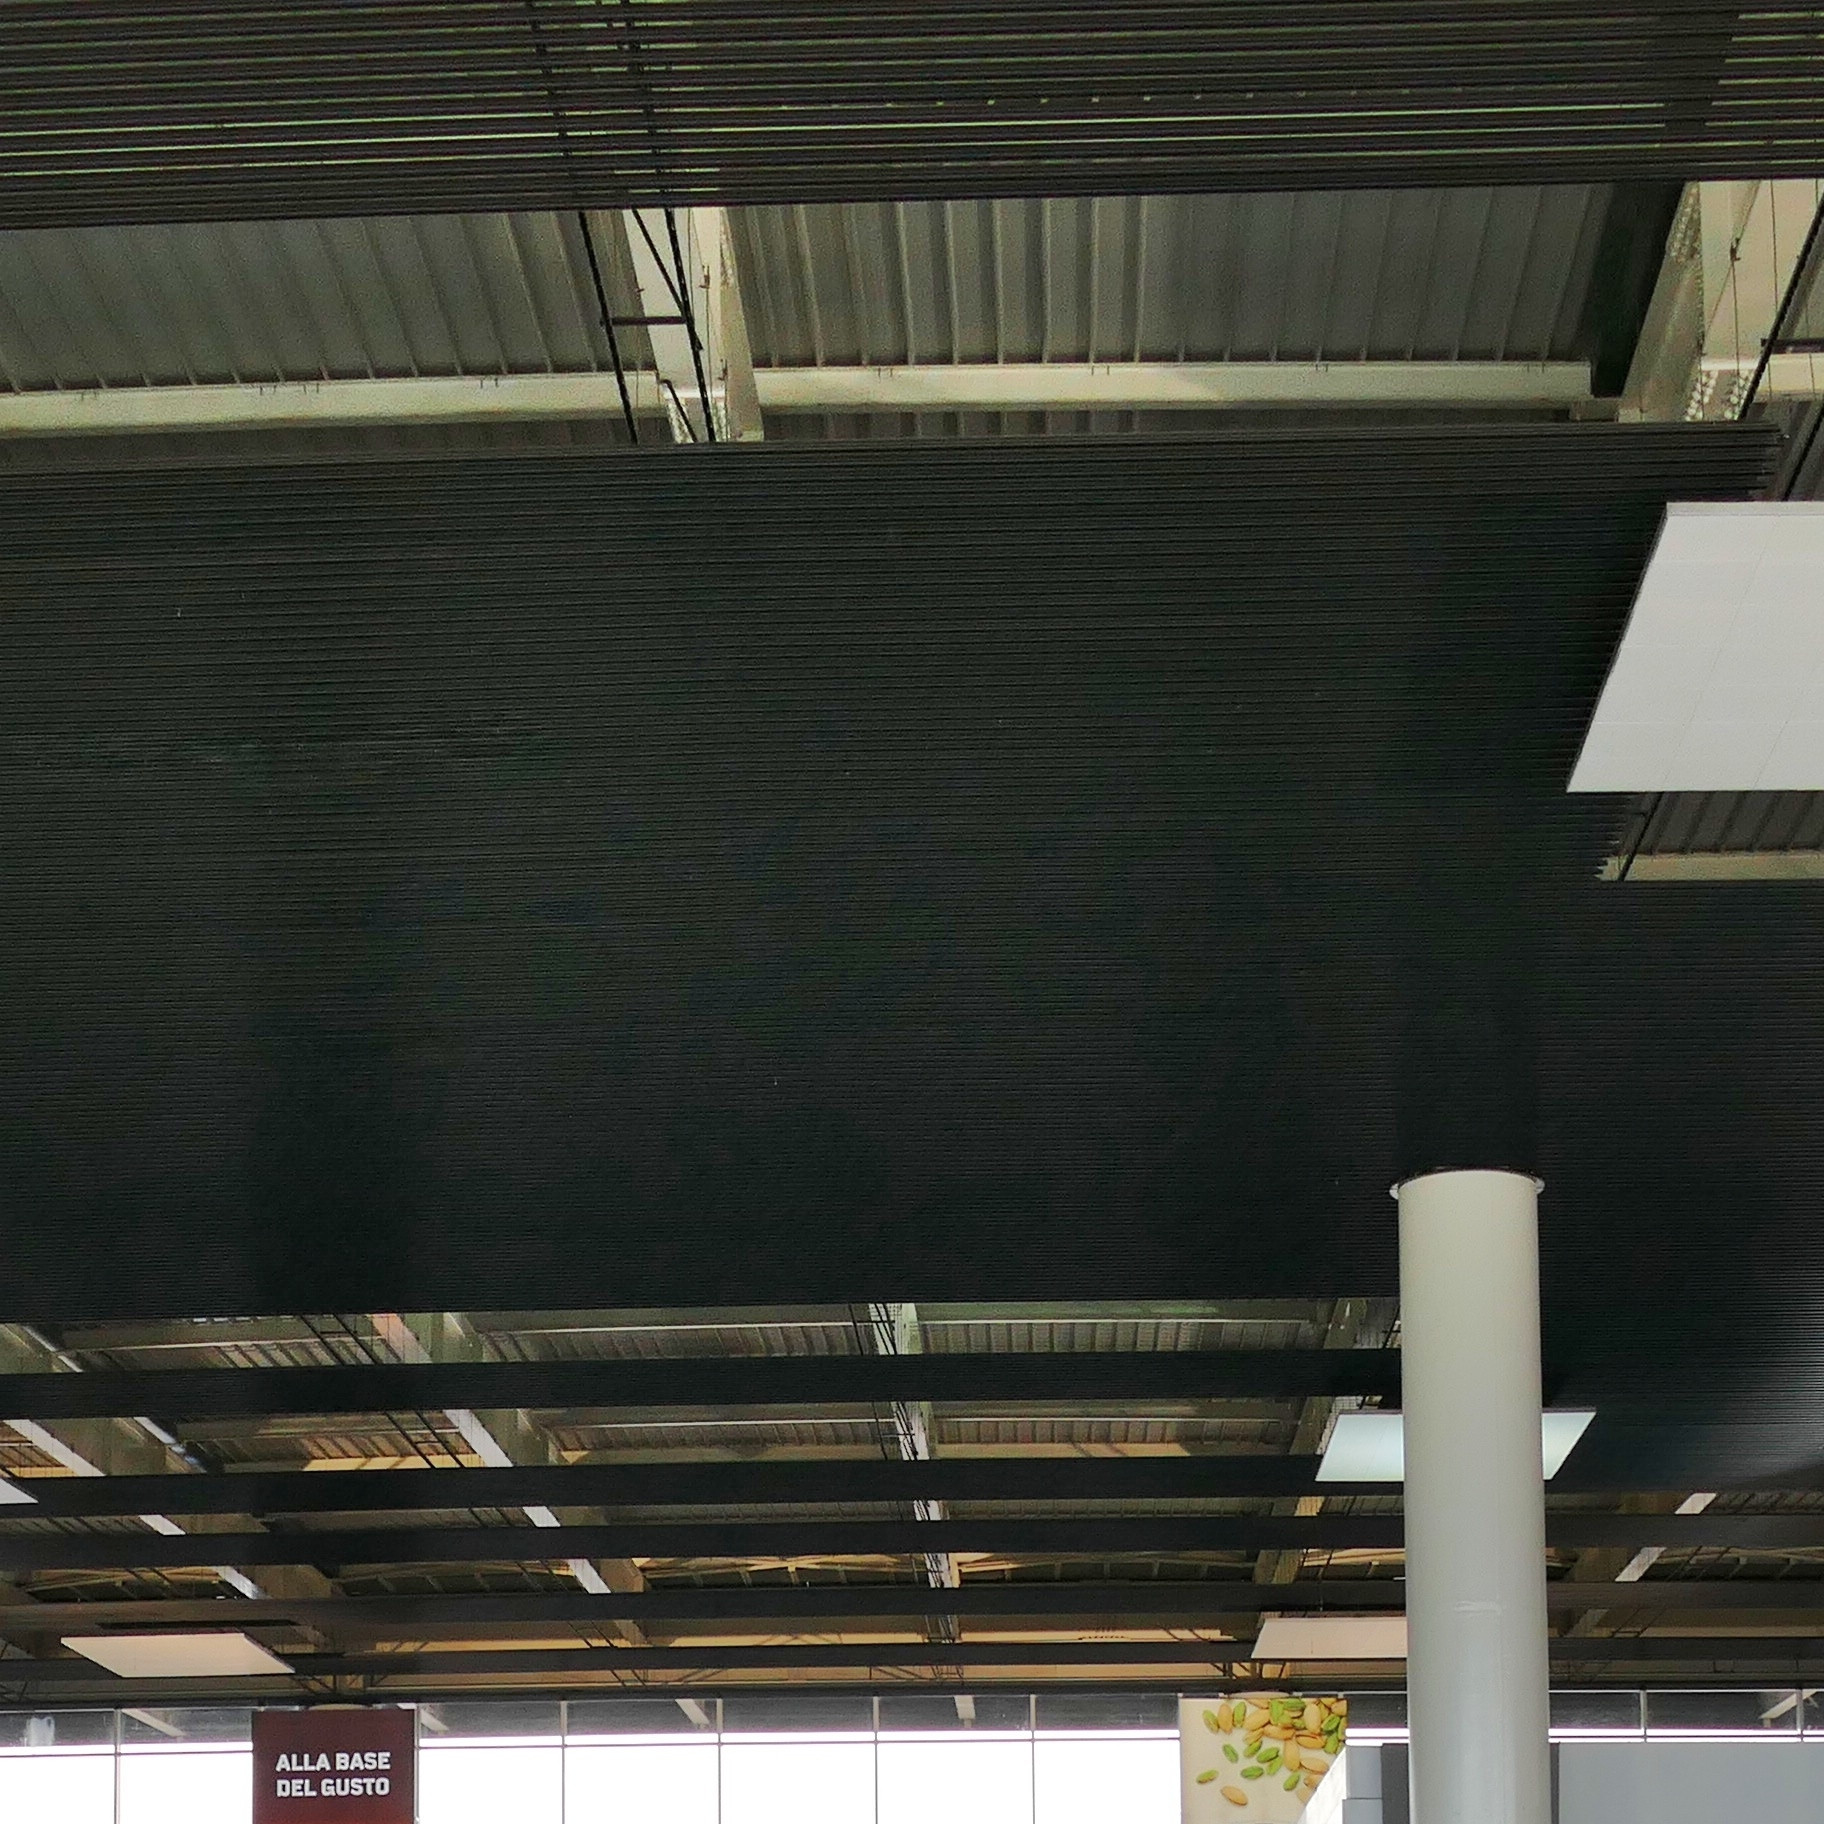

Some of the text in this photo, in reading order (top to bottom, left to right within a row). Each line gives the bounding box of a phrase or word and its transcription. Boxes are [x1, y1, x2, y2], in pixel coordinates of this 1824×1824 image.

[275, 1751, 392, 1772] ALLA BASE
[276, 1777, 391, 1797] DEL GUSTO
